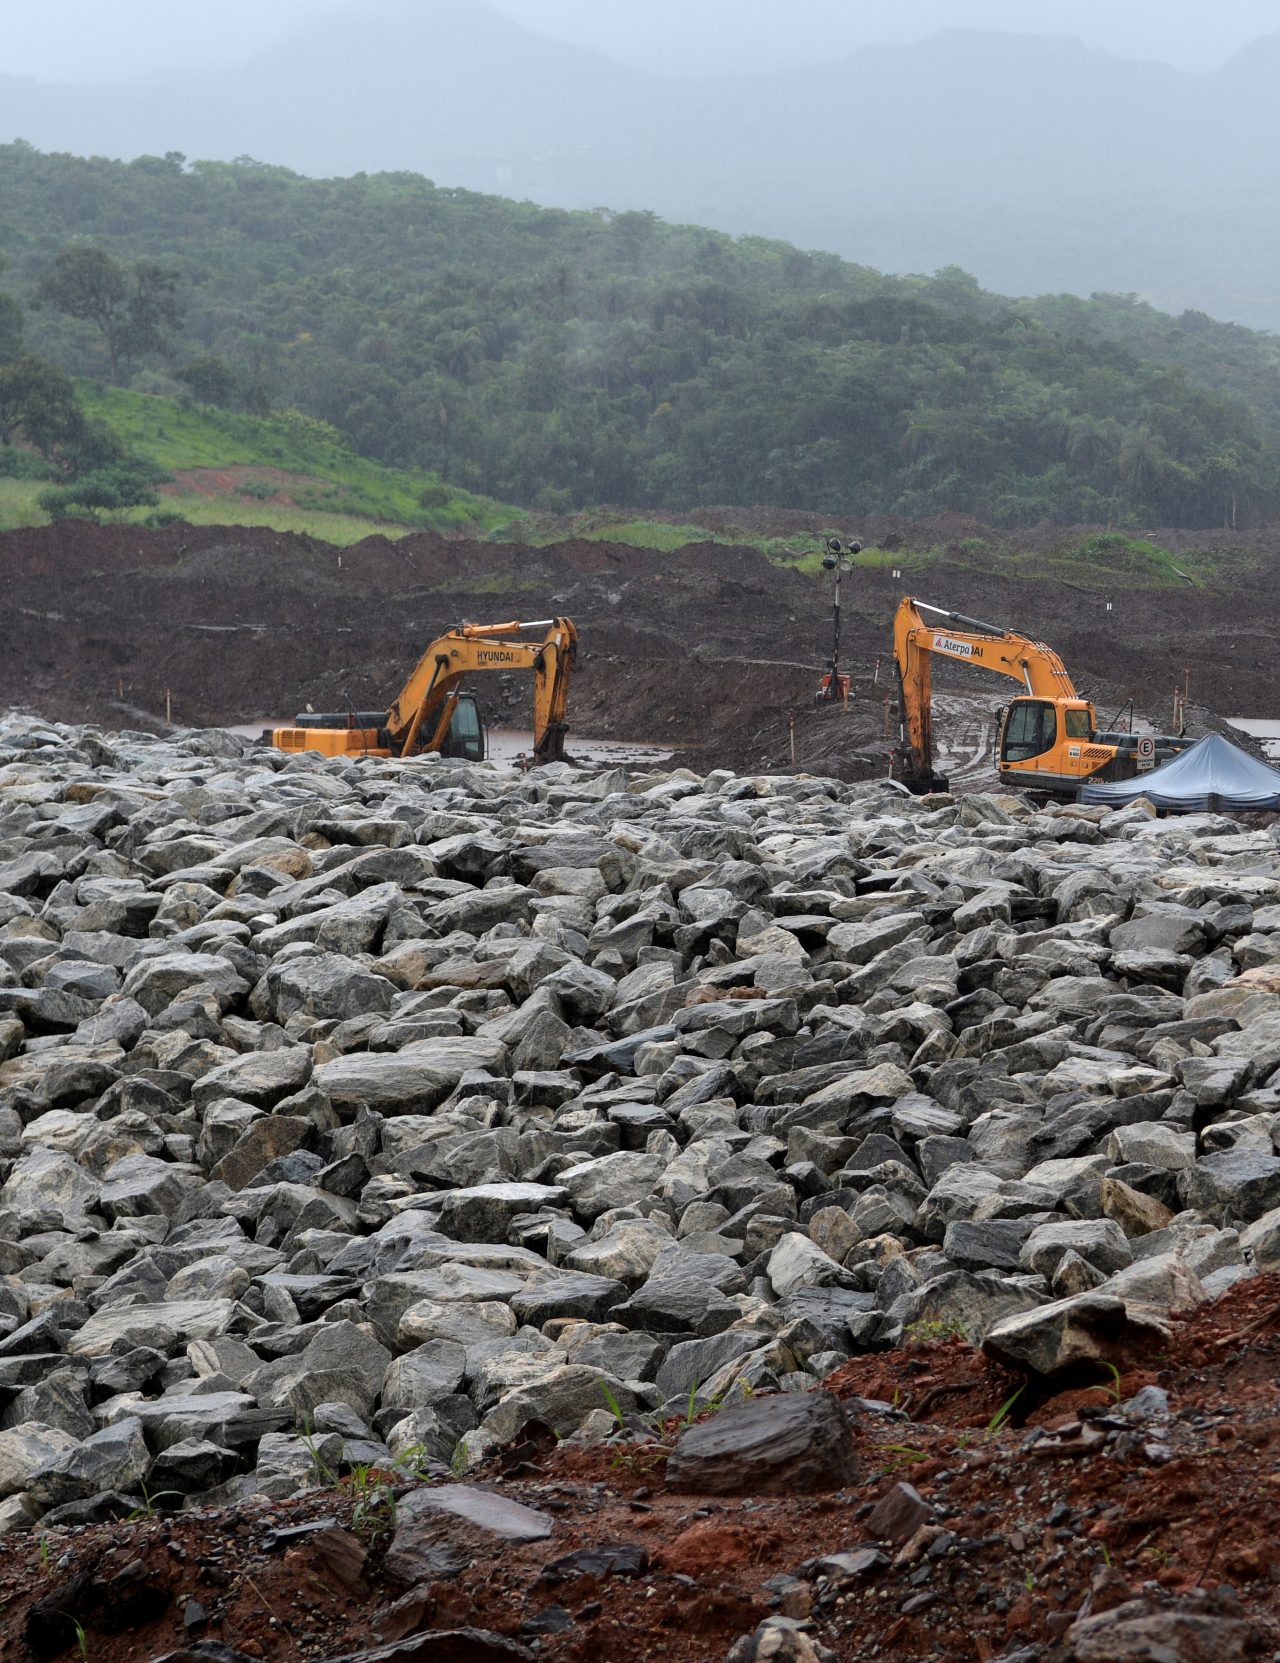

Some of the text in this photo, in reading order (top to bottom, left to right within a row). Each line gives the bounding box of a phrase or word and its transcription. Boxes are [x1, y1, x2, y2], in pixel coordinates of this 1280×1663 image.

[943, 639, 970, 655] Aterpa
[477, 650, 514, 662] HYUNDAI
[1143, 742, 1150, 753] E
